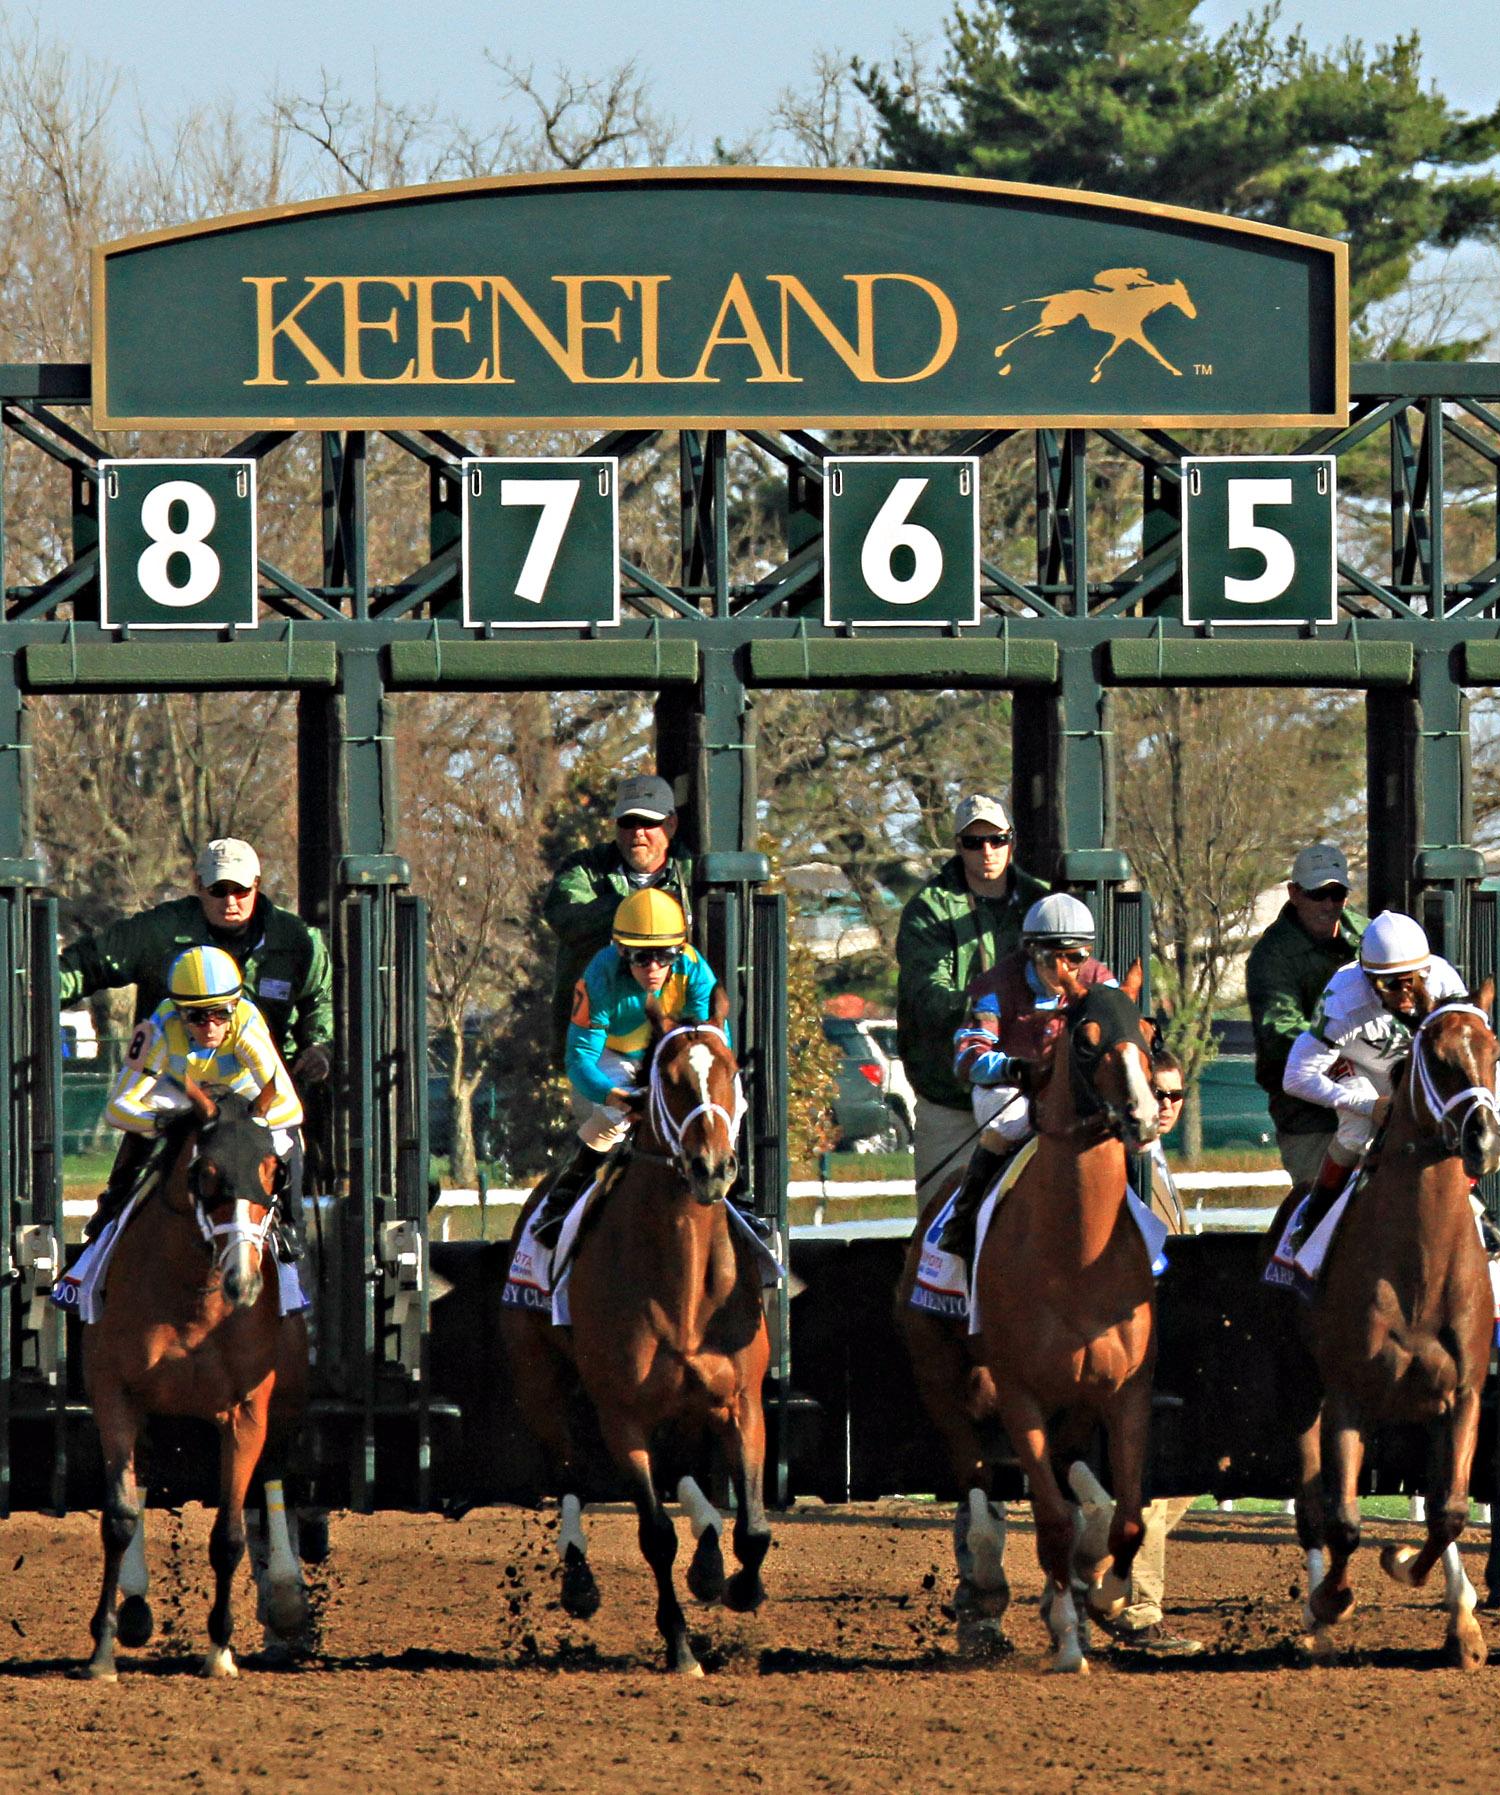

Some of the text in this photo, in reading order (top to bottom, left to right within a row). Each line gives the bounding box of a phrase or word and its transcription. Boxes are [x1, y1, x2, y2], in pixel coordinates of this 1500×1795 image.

[242, 273, 958, 386] KEENELAND
[1193, 364, 1213, 375] TM
[138, 480, 221, 607] 8
[501, 480, 580, 604] 7
[861, 479, 943, 604] 6
[1224, 479, 1296, 604] 5
[129, 1031, 145, 1060] 8
